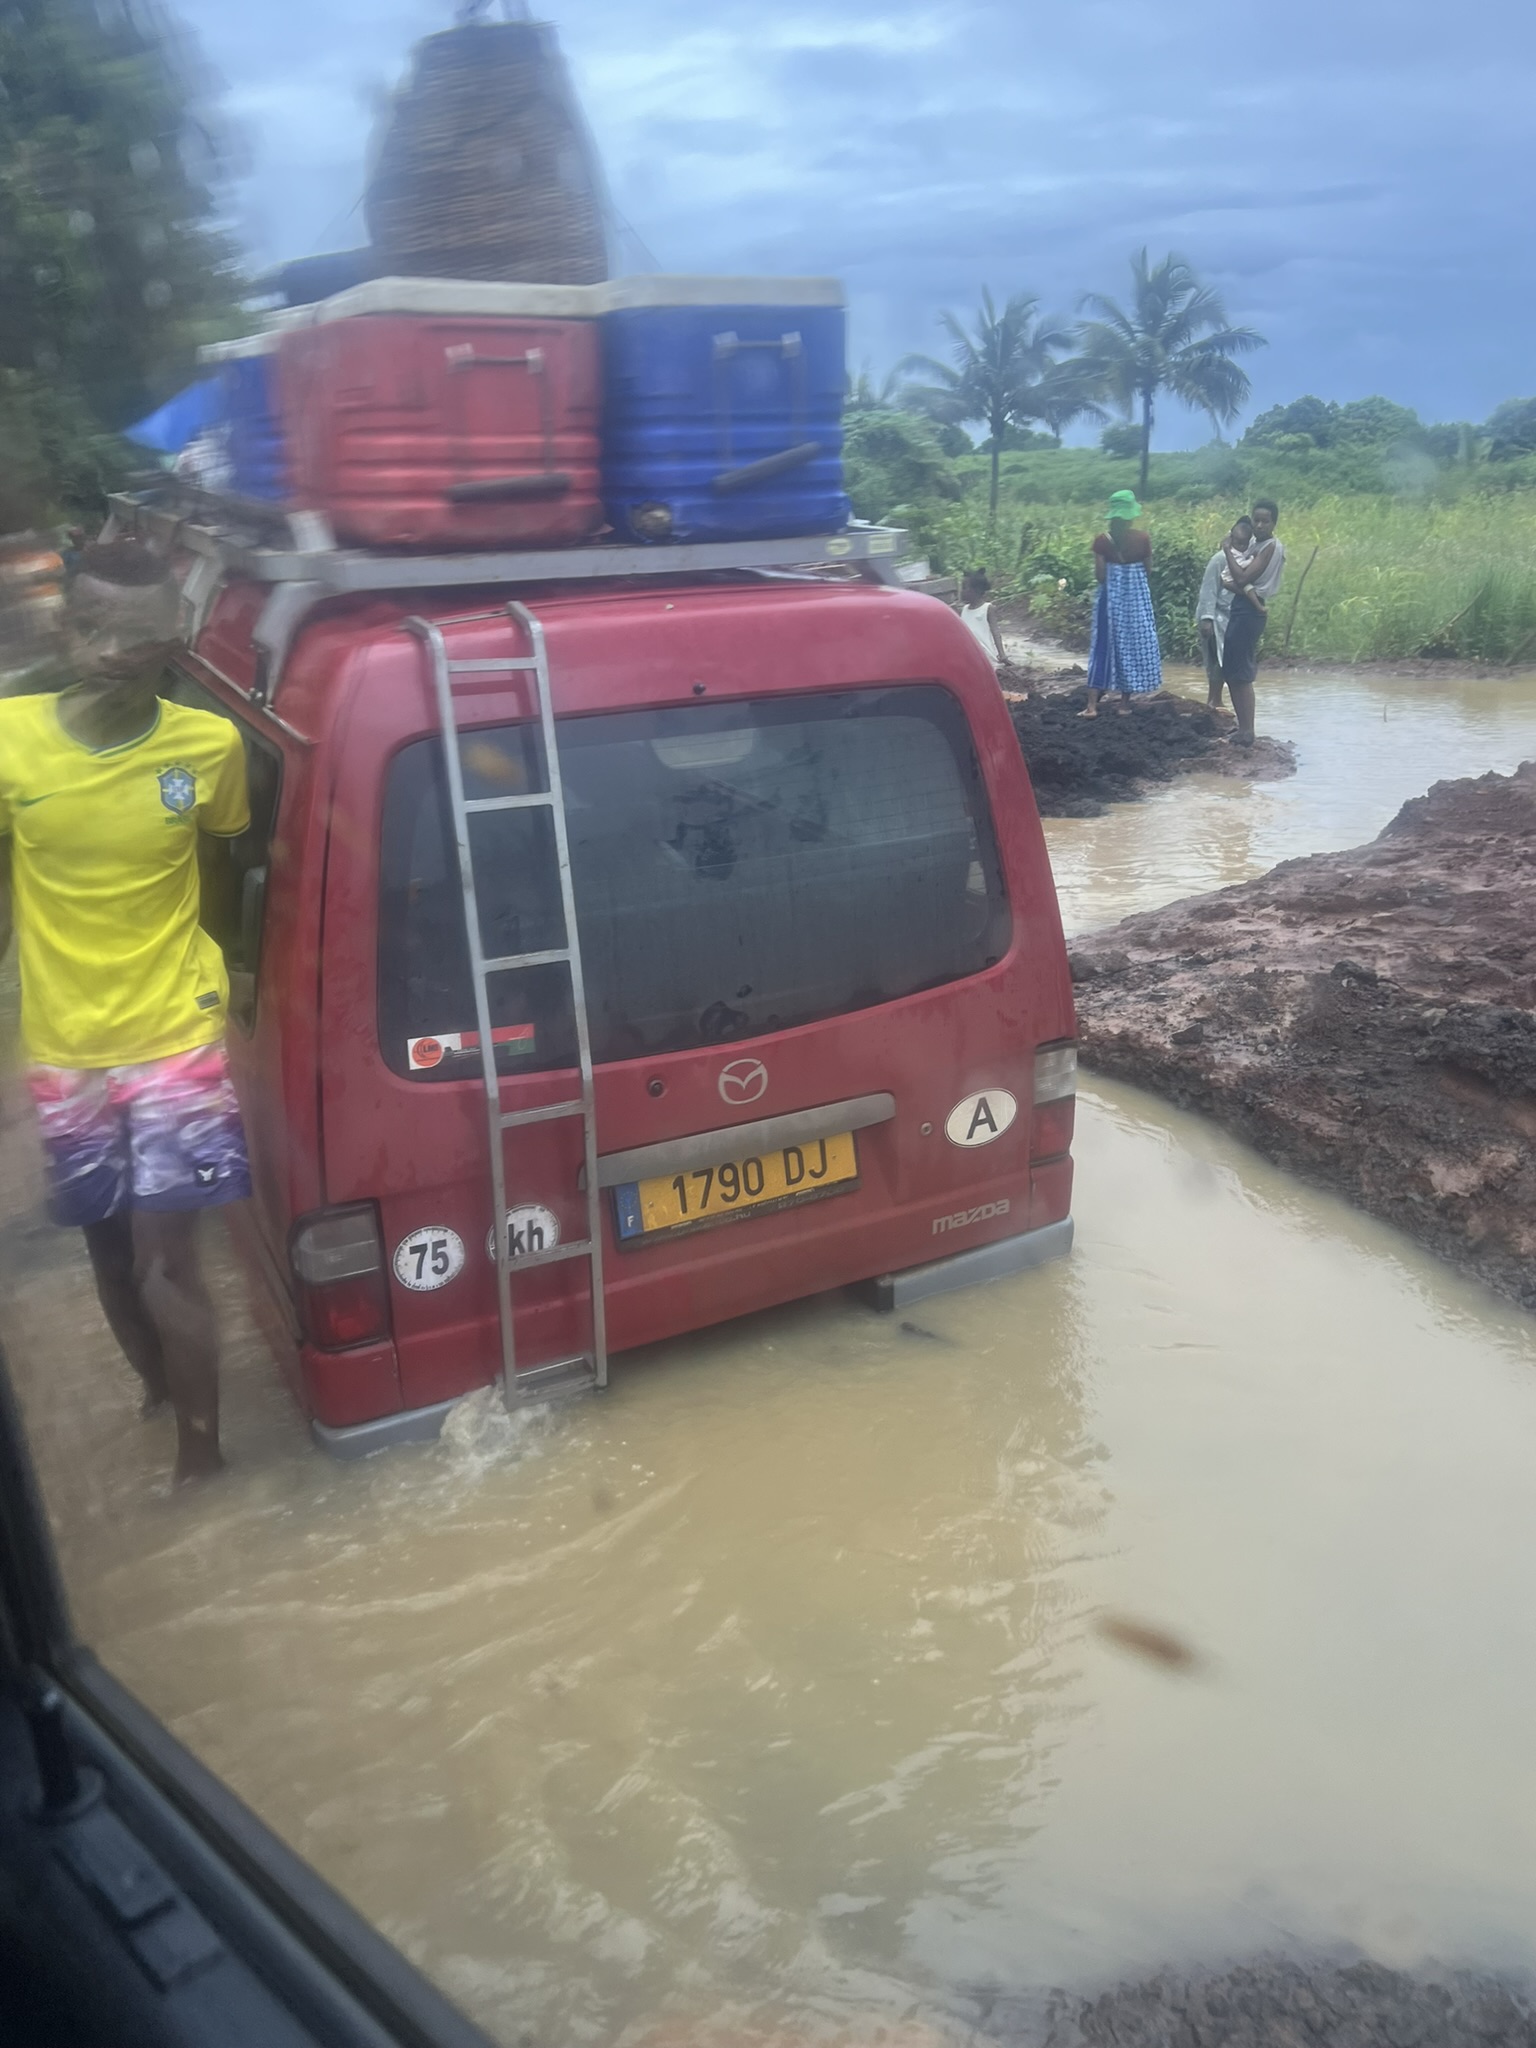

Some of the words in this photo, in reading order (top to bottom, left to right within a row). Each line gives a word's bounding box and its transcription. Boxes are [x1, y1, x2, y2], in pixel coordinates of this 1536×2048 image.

[966, 1097, 998, 1140] A
[672, 1156, 765, 1215] 1790
[783, 1138, 827, 1187] DJ
[507, 1219, 544, 1257] kh
[627, 1215, 635, 1228] F
[409, 1238, 450, 1280] 75
